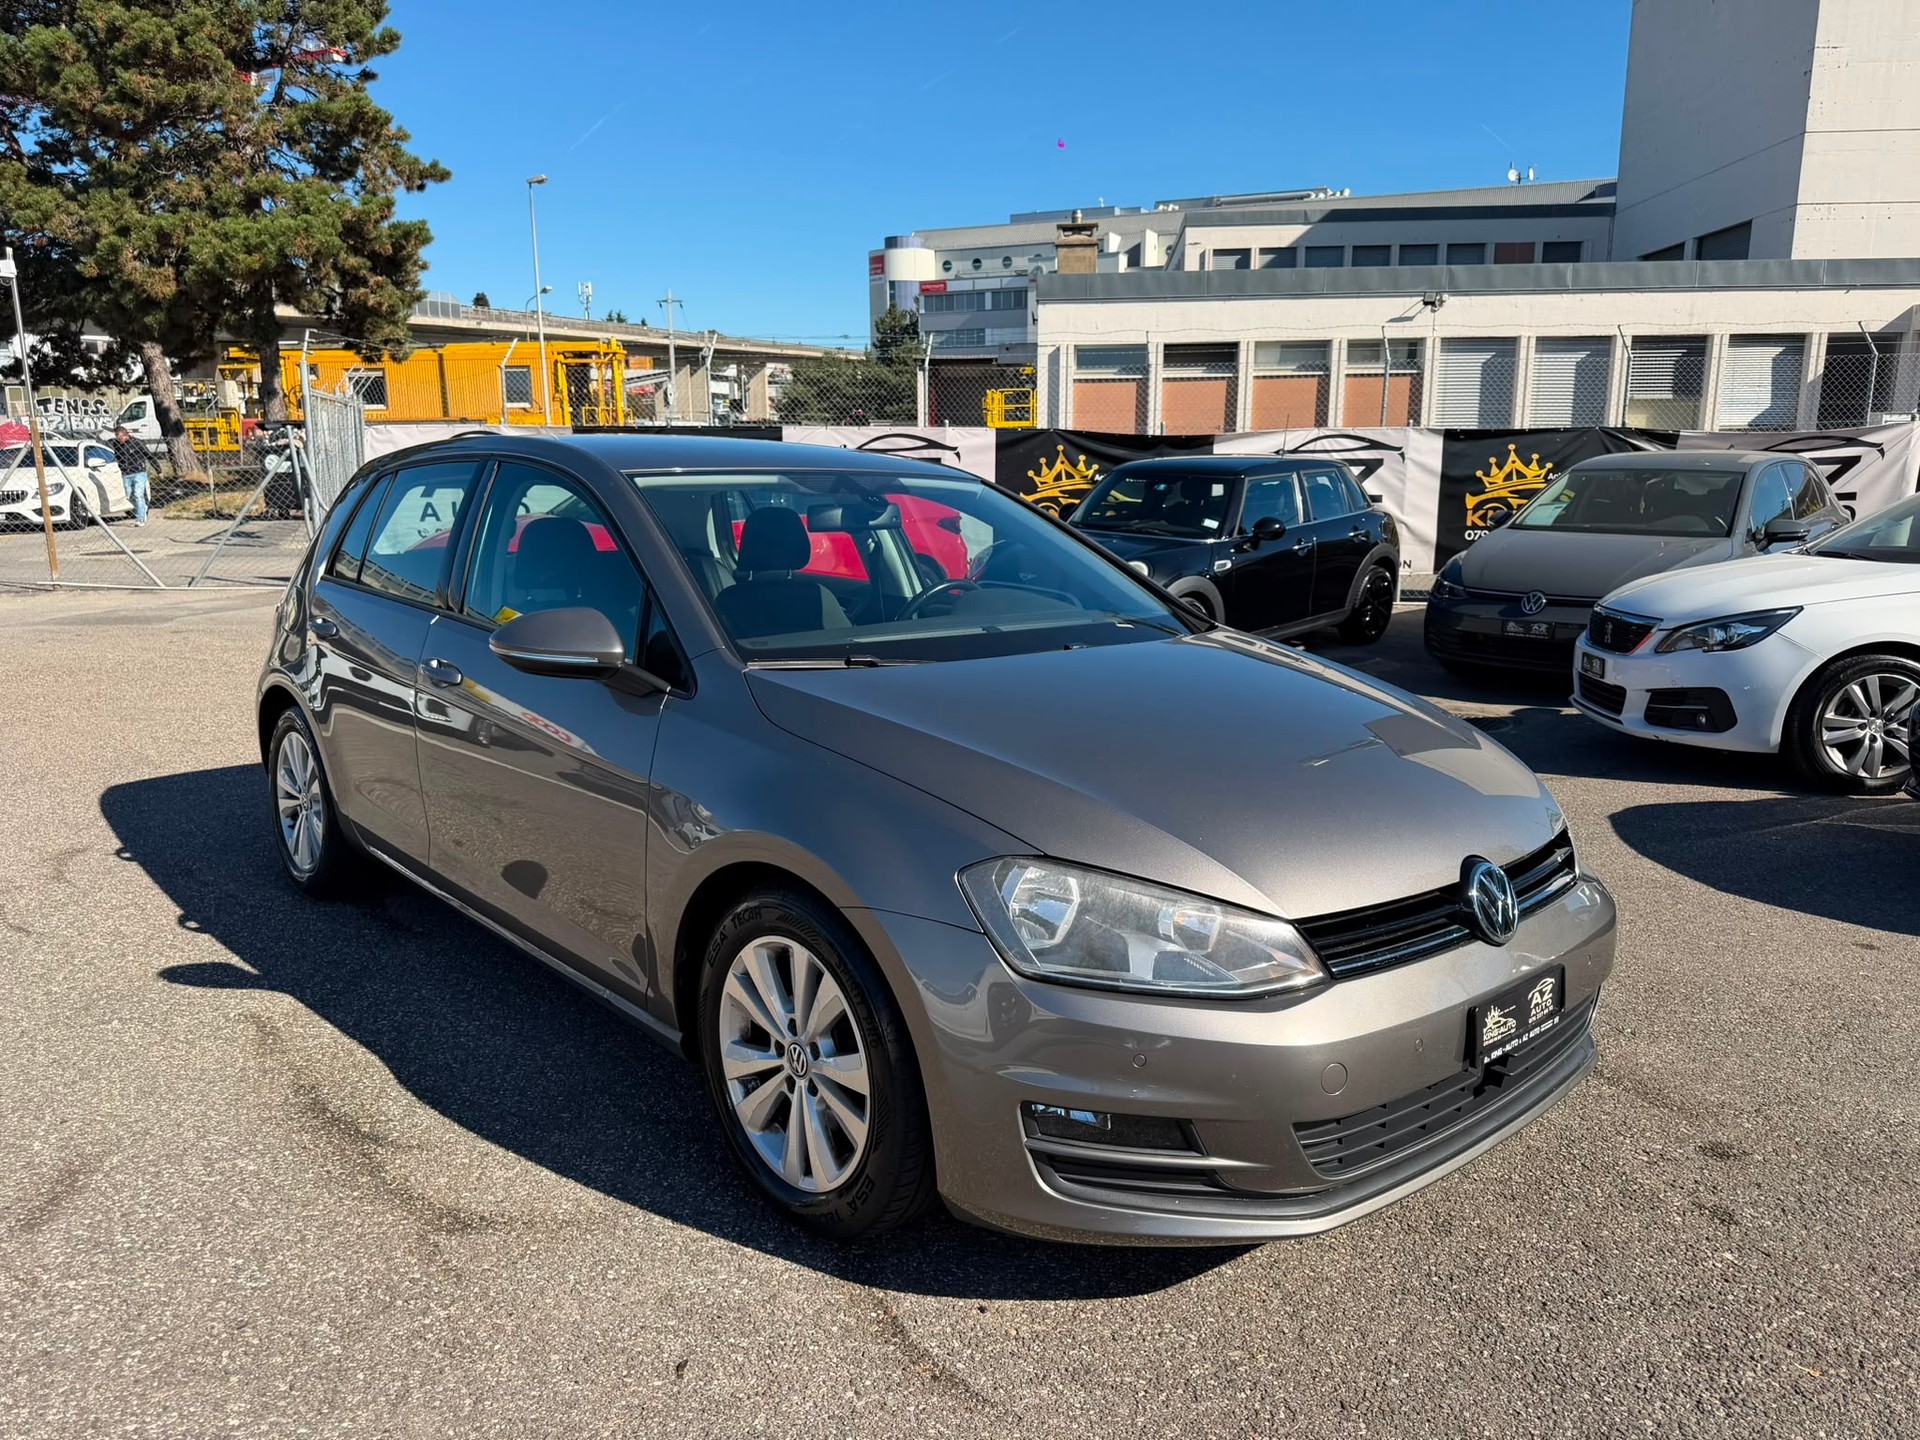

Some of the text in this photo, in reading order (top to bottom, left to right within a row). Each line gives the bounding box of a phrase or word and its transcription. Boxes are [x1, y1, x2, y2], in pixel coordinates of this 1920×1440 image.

[731, 904, 763, 930] TECAR
[1530, 983, 1553, 1008] AZ
[1530, 999, 1552, 1016] AUTO
[863, 1015, 881, 1049] PRO
